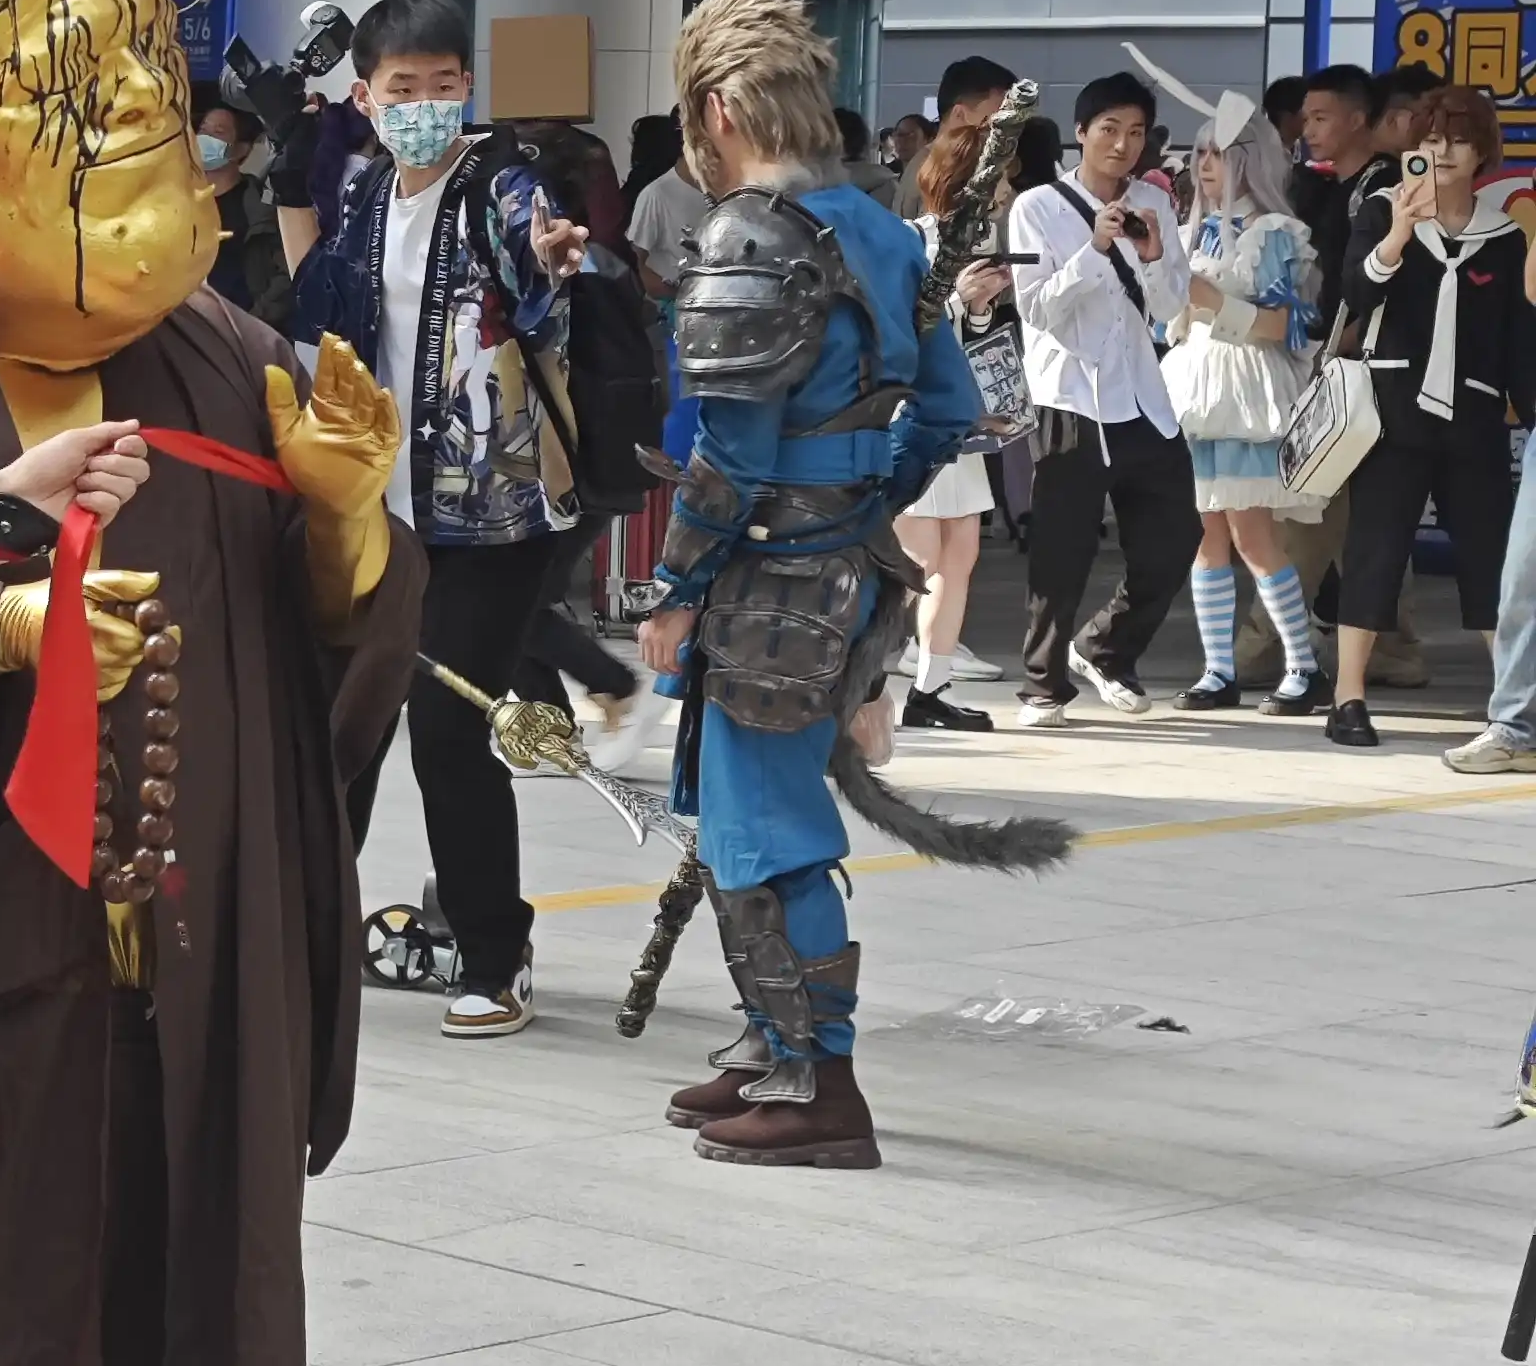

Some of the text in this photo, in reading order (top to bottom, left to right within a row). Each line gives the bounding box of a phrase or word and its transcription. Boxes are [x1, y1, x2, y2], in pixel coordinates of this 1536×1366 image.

[184, 17, 211, 41] 5/6
[1397, 12, 1536, 96] 8同
[427, 309, 443, 333] THE
